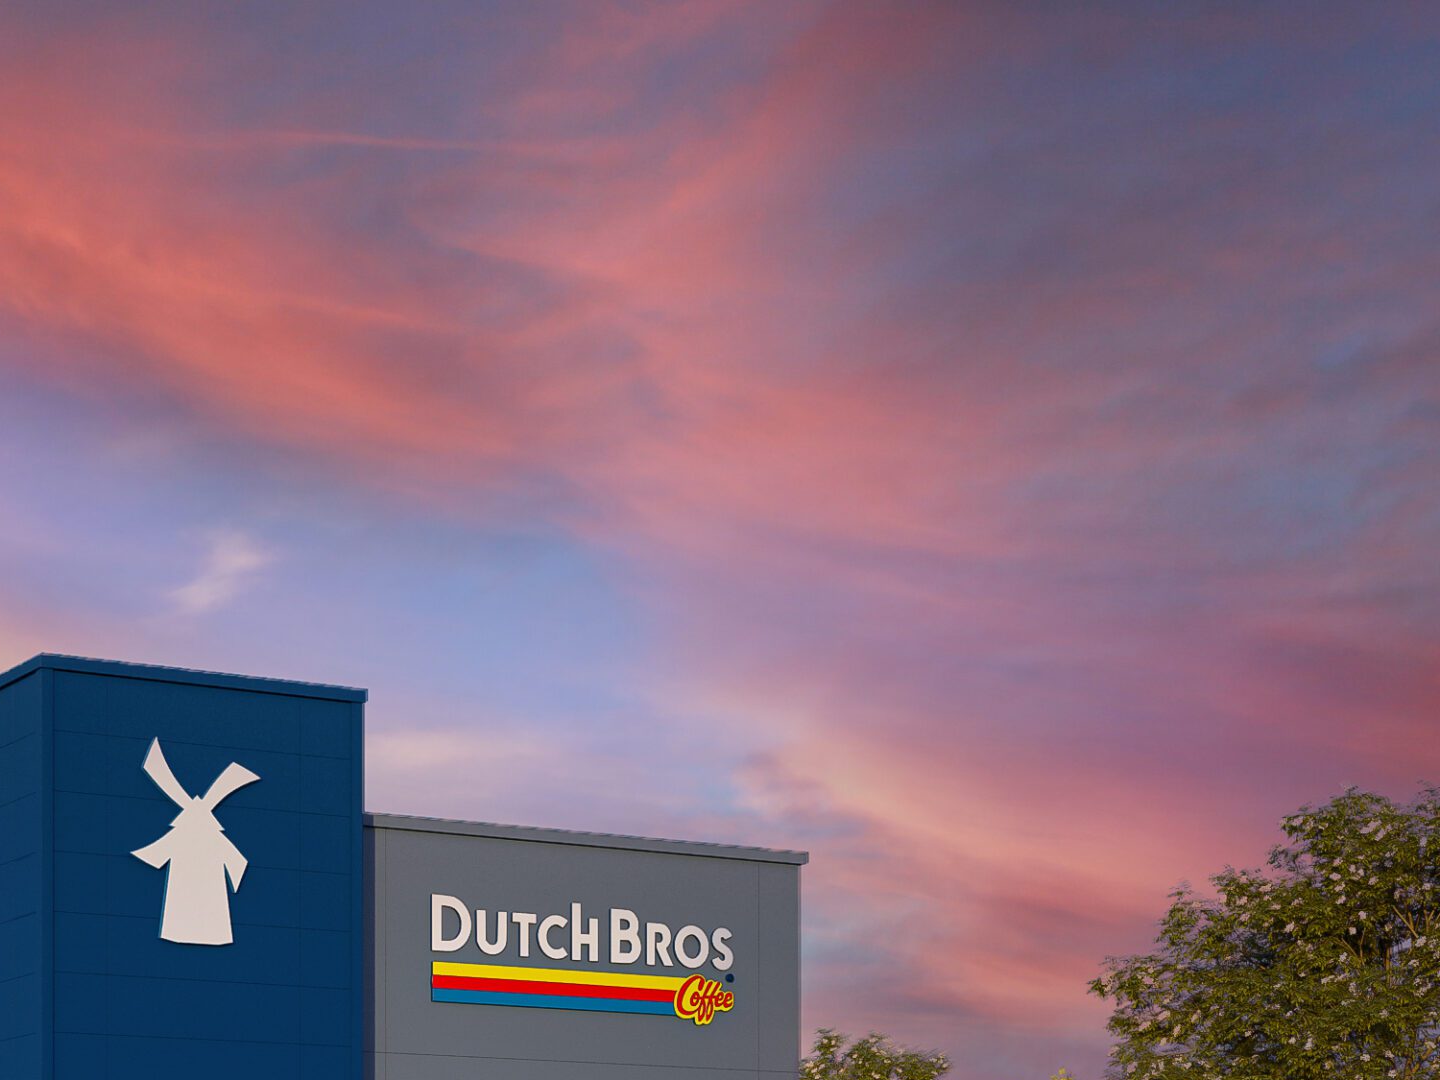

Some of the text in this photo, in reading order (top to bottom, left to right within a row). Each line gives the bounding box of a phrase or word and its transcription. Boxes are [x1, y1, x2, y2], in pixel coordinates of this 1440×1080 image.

[430, 892, 735, 972] DUTCH BROS
[675, 974, 734, 1024] Coffee
